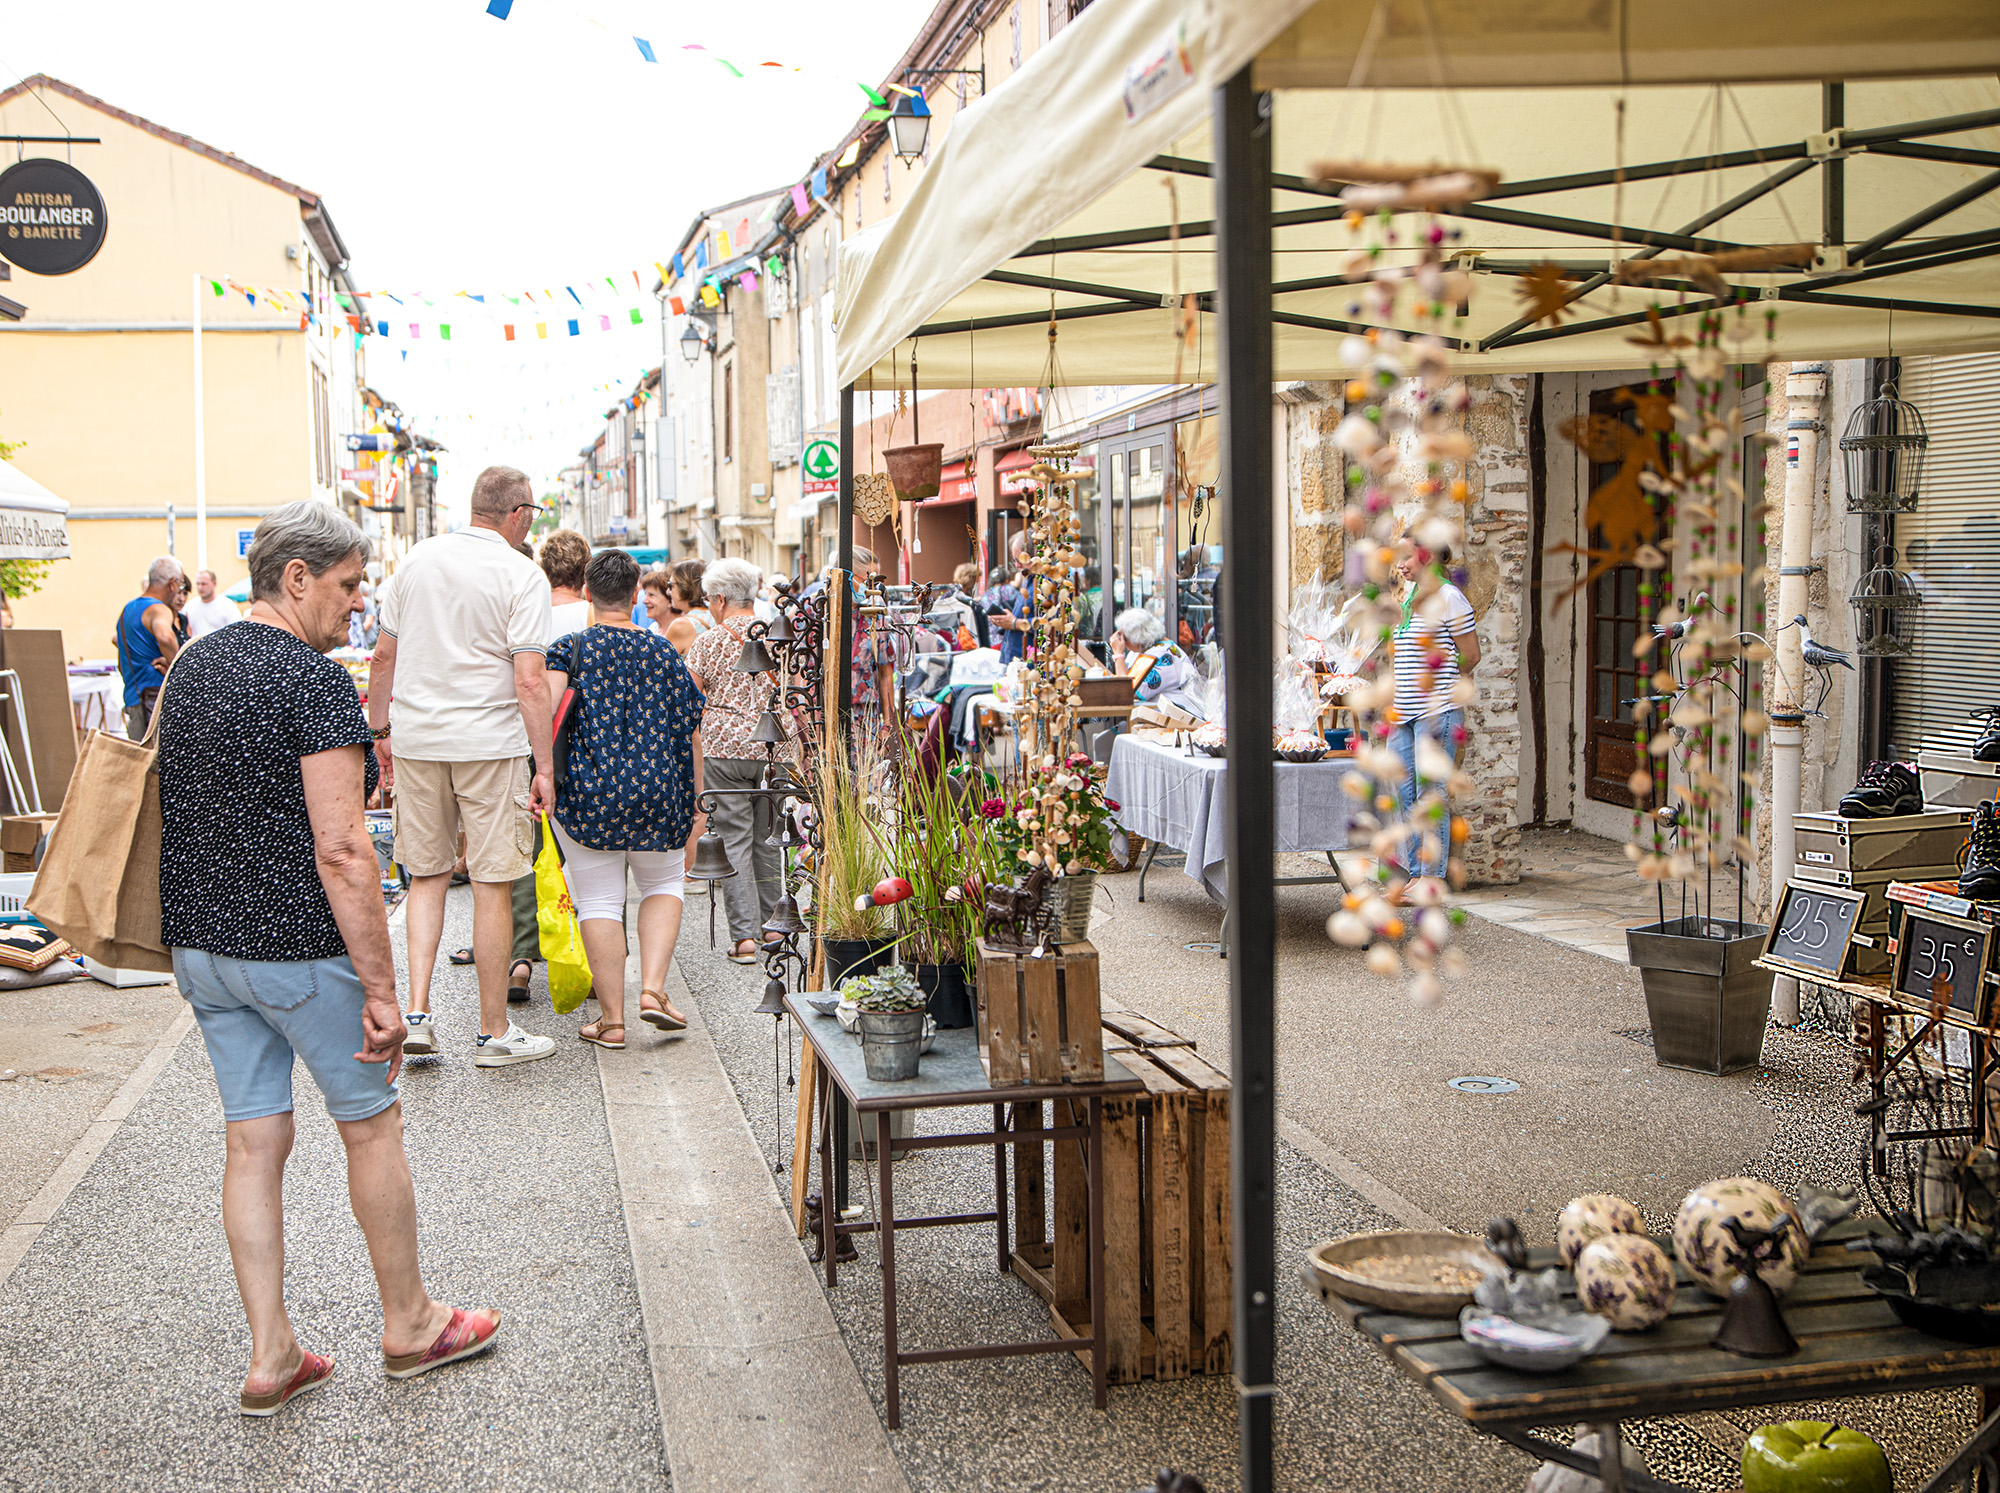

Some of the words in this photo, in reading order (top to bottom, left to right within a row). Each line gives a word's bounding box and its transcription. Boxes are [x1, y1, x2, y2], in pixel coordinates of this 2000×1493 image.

[15, 192, 72, 206] ARTISAN
[0, 206, 94, 225] BOULANGER
[8, 225, 19, 239] &
[22, 225, 81, 240] BANETTE
